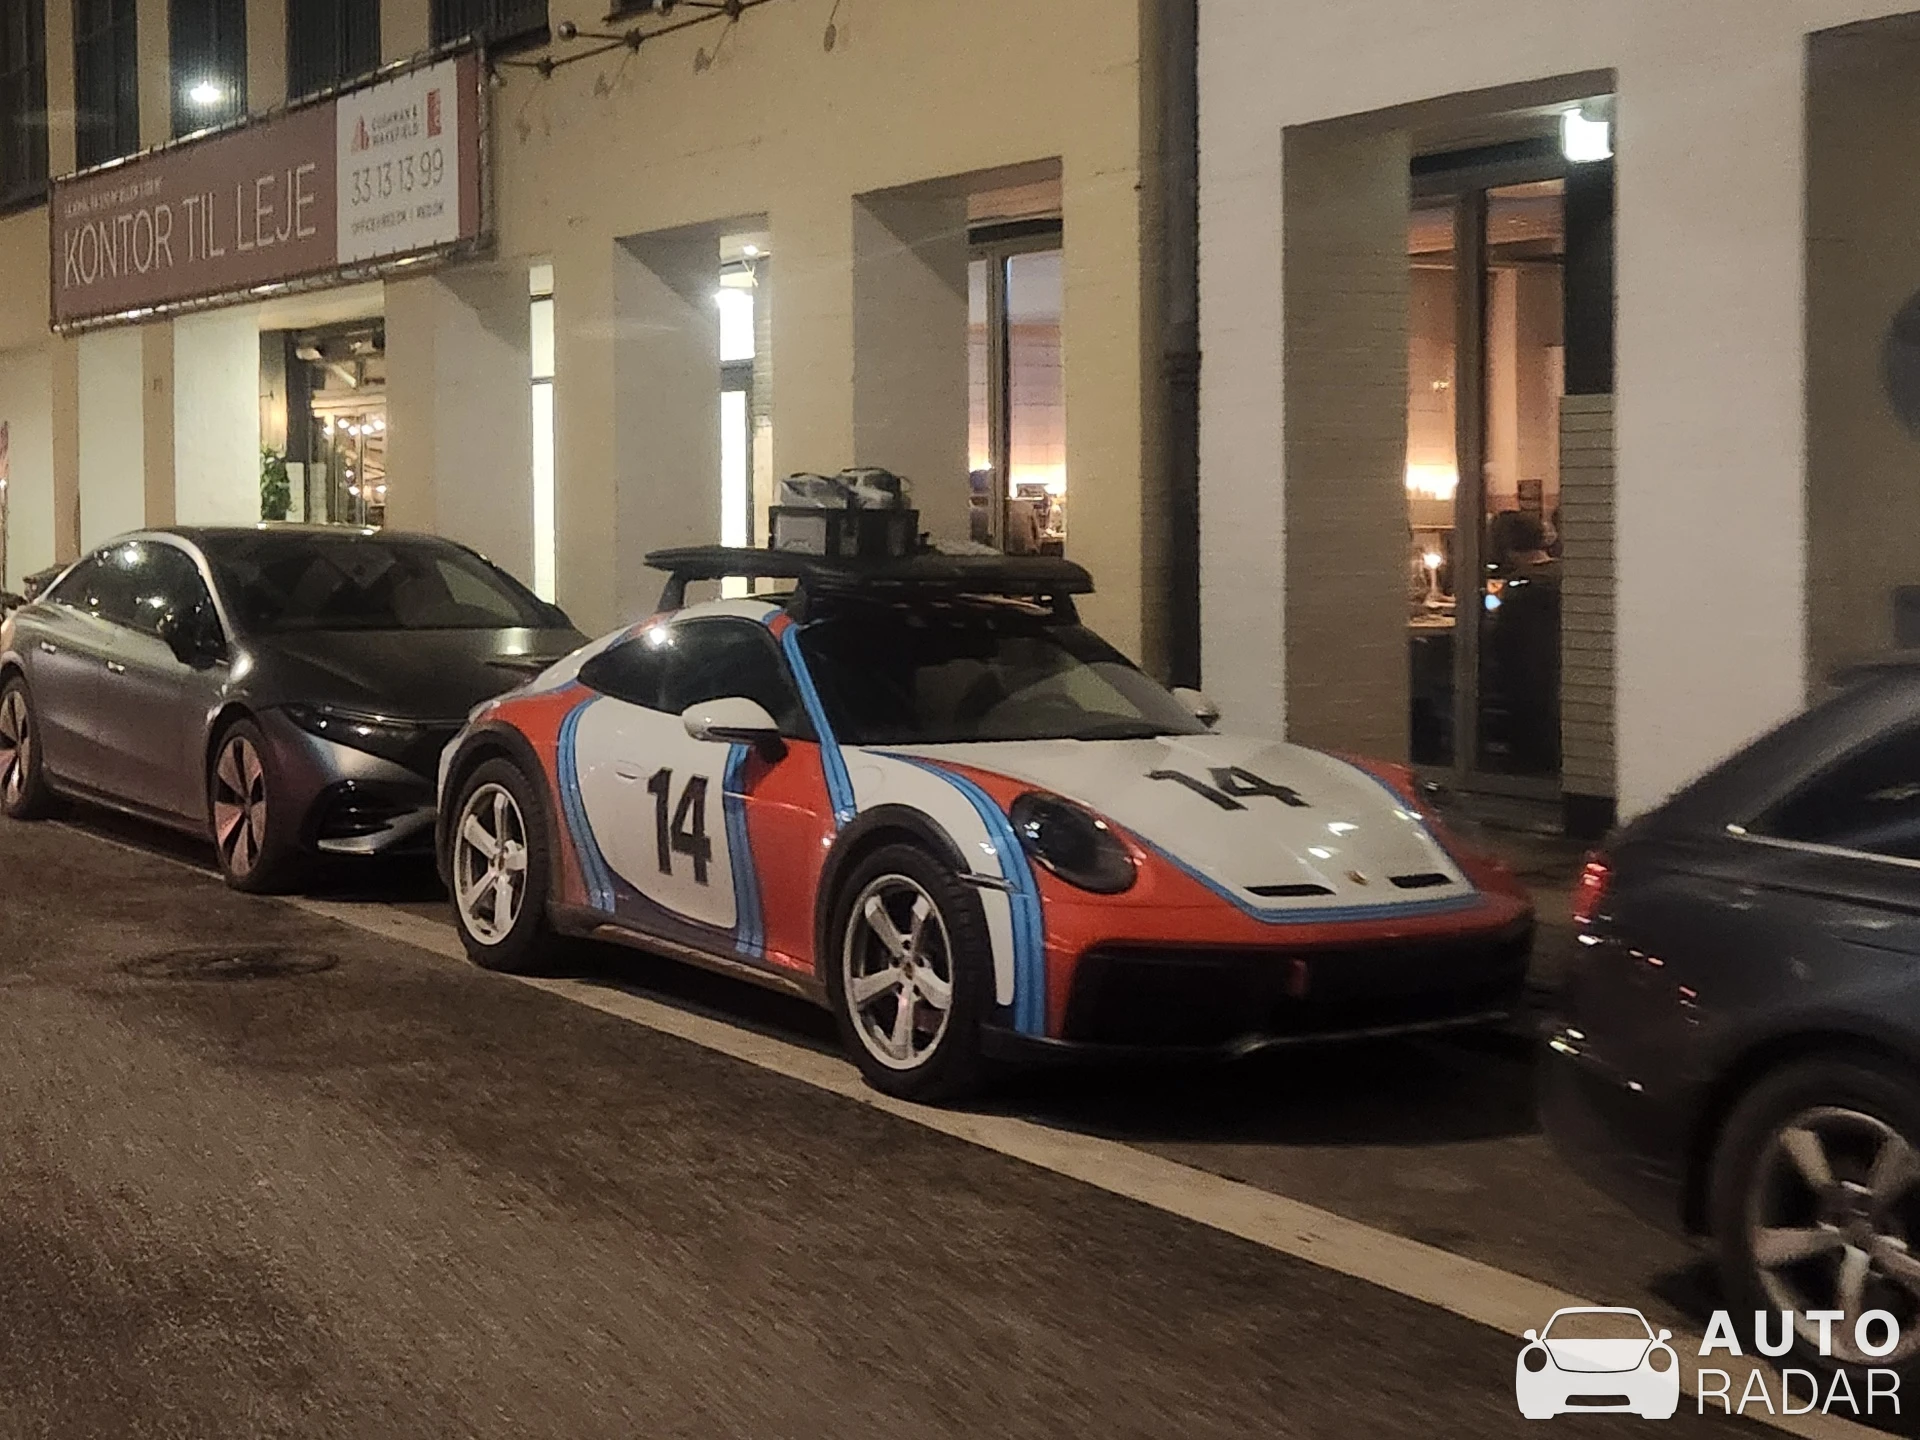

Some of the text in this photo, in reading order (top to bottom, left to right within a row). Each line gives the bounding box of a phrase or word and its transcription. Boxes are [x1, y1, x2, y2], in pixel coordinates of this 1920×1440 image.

[352, 148, 444, 206] 33 13 13 99
[64, 204, 173, 288] KONTOR
[182, 192, 225, 262] TIL
[237, 162, 316, 251] LEJE
[646, 766, 713, 888] 14
[1142, 765, 1313, 812] 14
